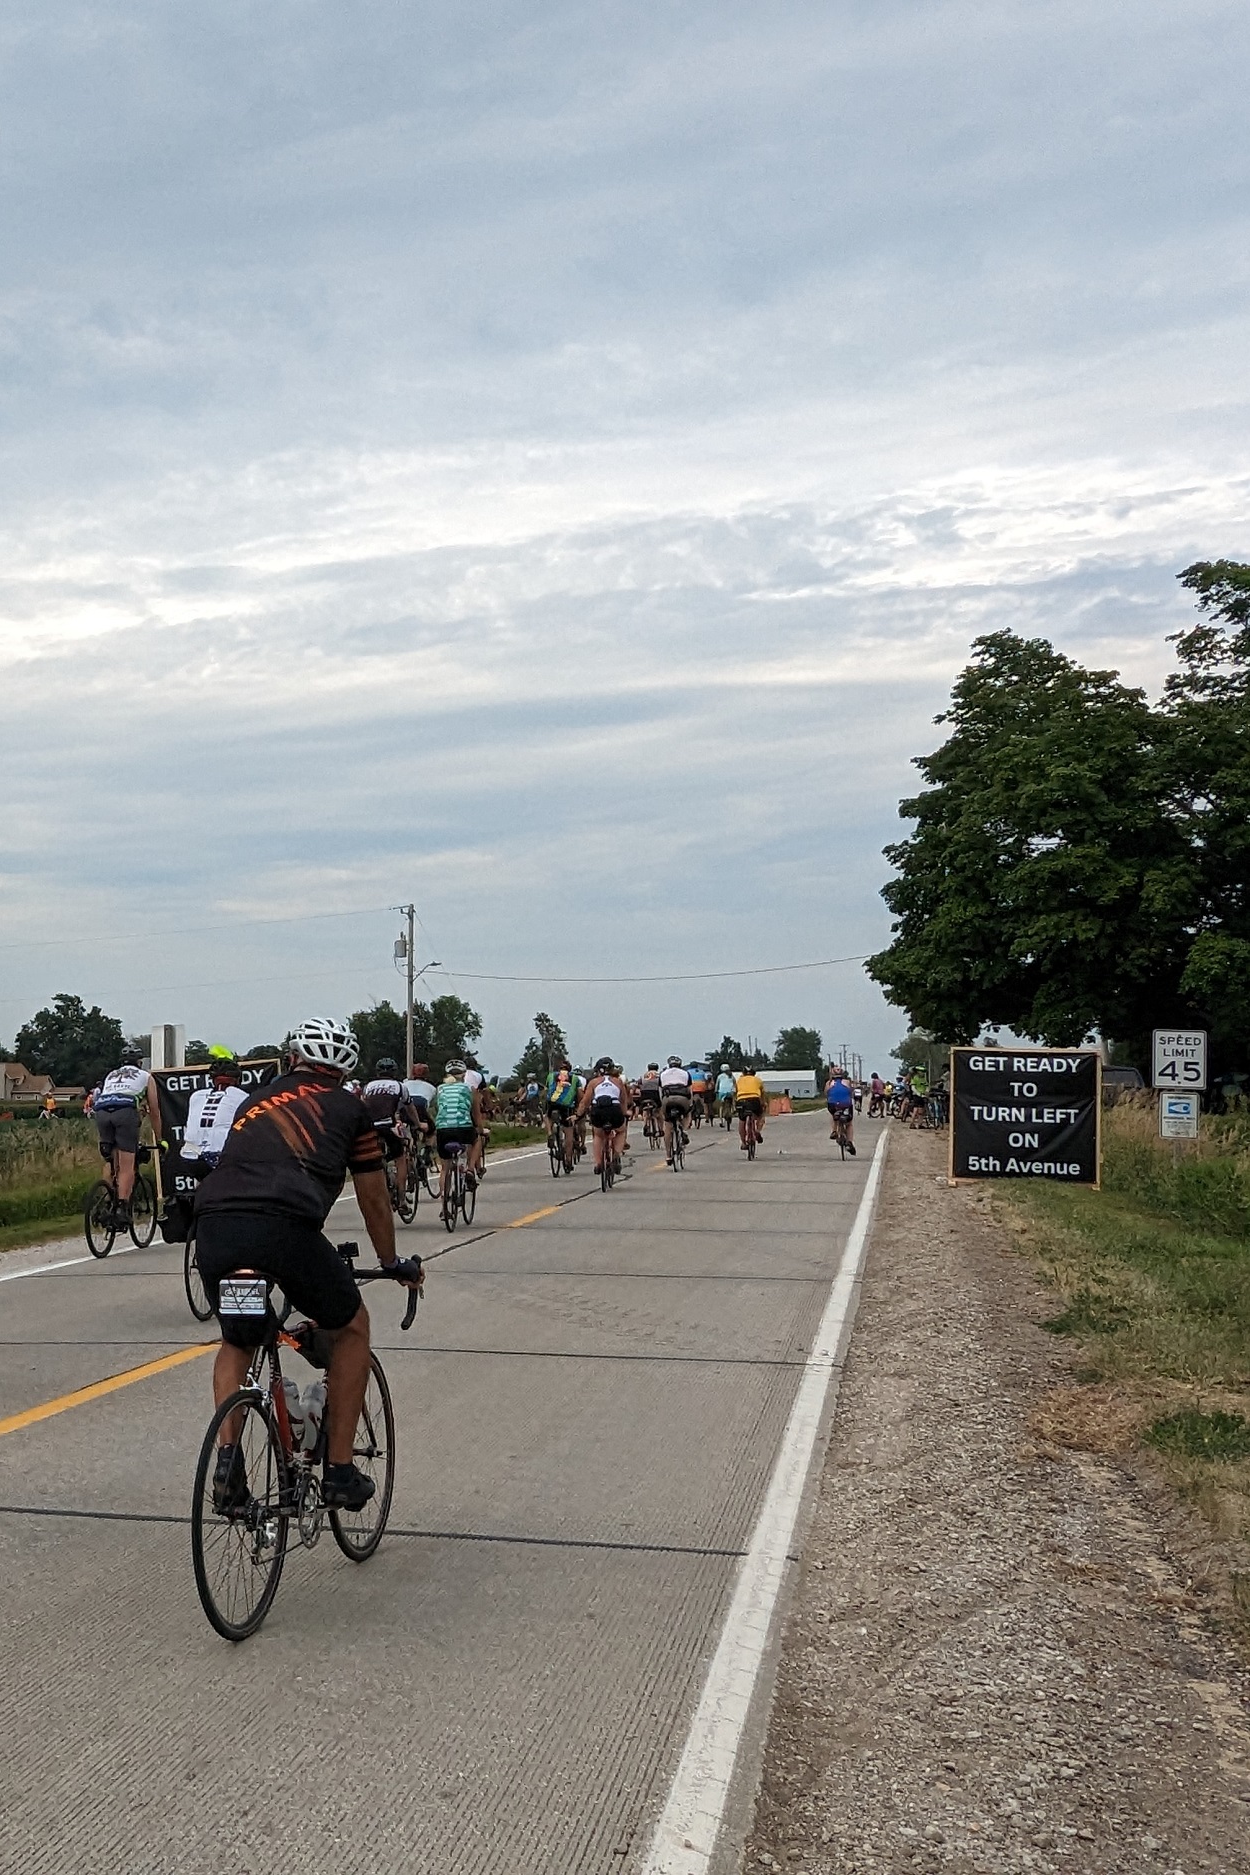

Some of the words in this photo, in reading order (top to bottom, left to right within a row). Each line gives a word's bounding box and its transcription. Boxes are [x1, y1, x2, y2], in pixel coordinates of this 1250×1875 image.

[1158, 1035, 1202, 1046] SPEED
[1163, 1048, 1196, 1058] LIMIT
[969, 1056, 1008, 1071] GET
[1013, 1057, 1081, 1073] READY
[1158, 1061, 1201, 1082] 45
[166, 1075, 200, 1091] GET
[1010, 1082, 1038, 1097] TO
[233, 1083, 333, 1131] PRIMAL
[970, 1105, 1025, 1122] TURN
[1031, 1107, 1079, 1124] LEFT
[1008, 1133, 1039, 1148] ON
[968, 1156, 1000, 1172] 5th
[1005, 1158, 1081, 1175] Avenue
